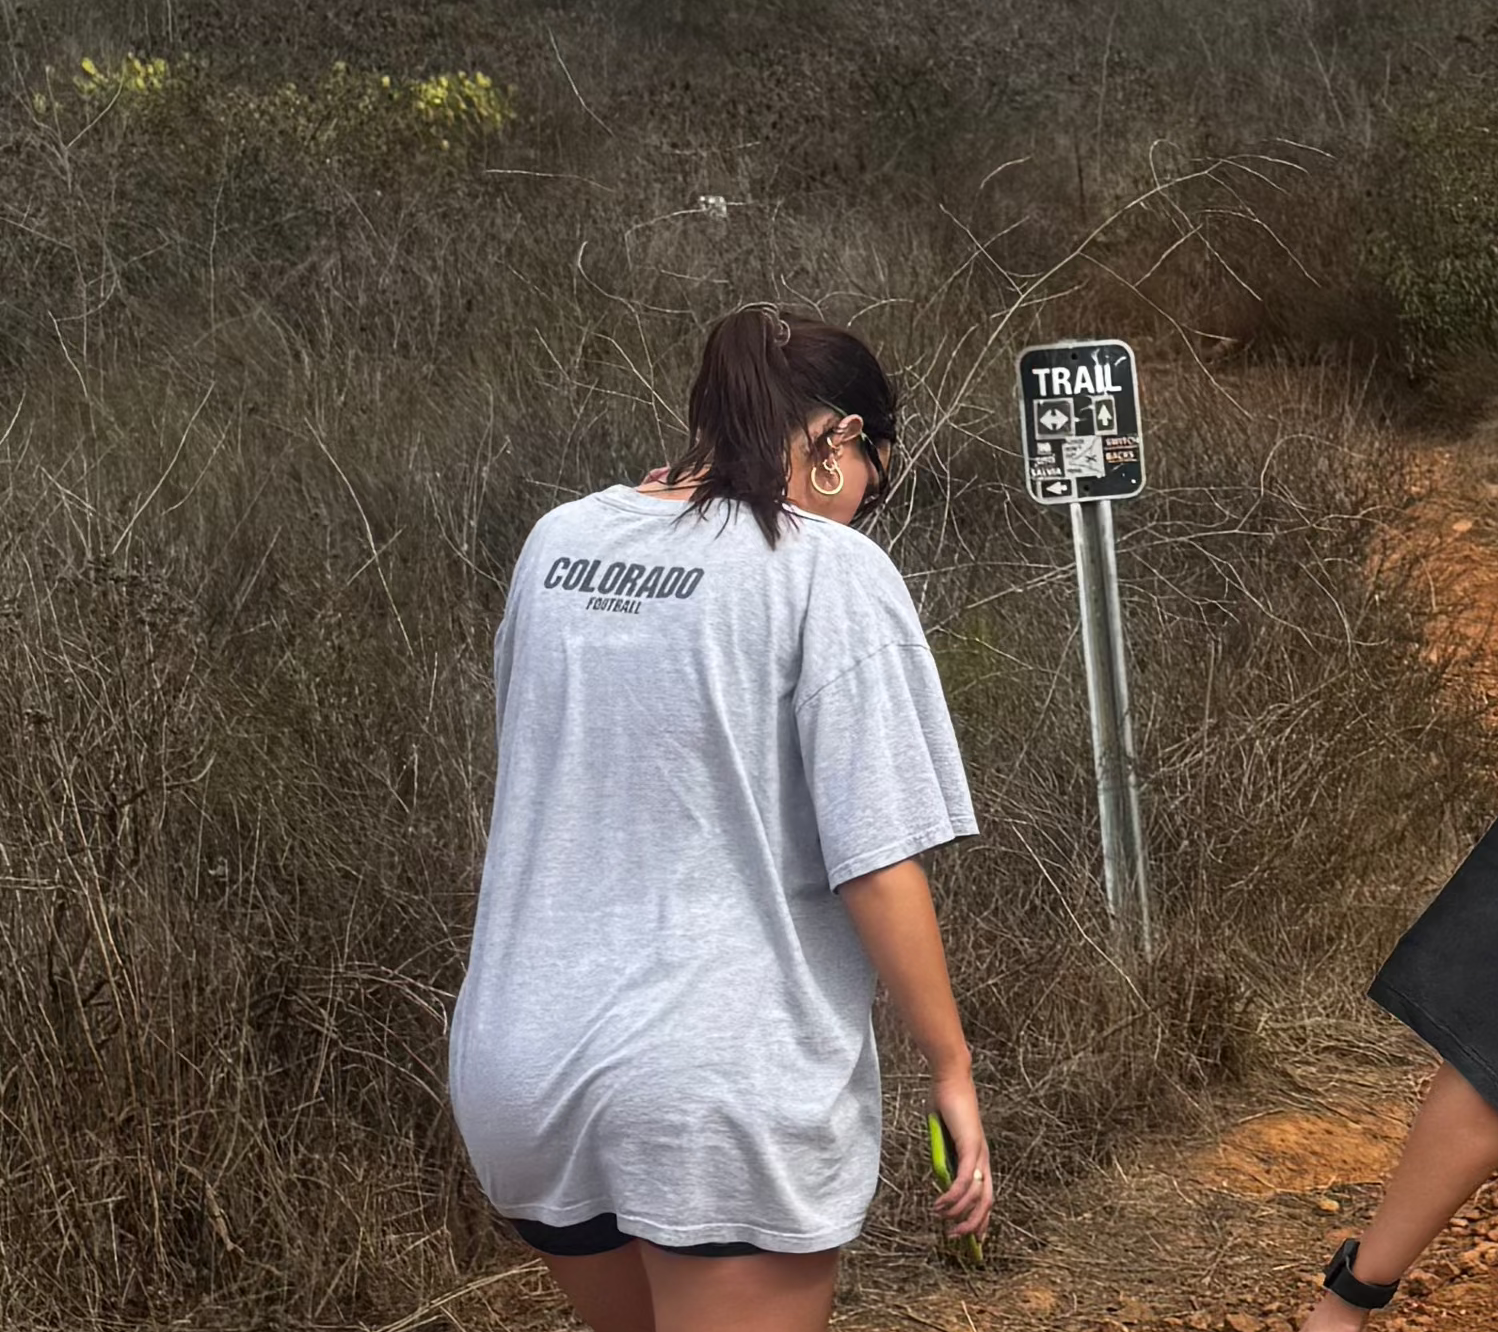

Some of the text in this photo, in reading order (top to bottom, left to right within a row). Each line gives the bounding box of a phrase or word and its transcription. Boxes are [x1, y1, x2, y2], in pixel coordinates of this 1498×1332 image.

[1032, 364, 1122, 397] TRAIL
[543, 556, 705, 599] COLORADO
[585, 597, 642, 615] FOOTBALL
